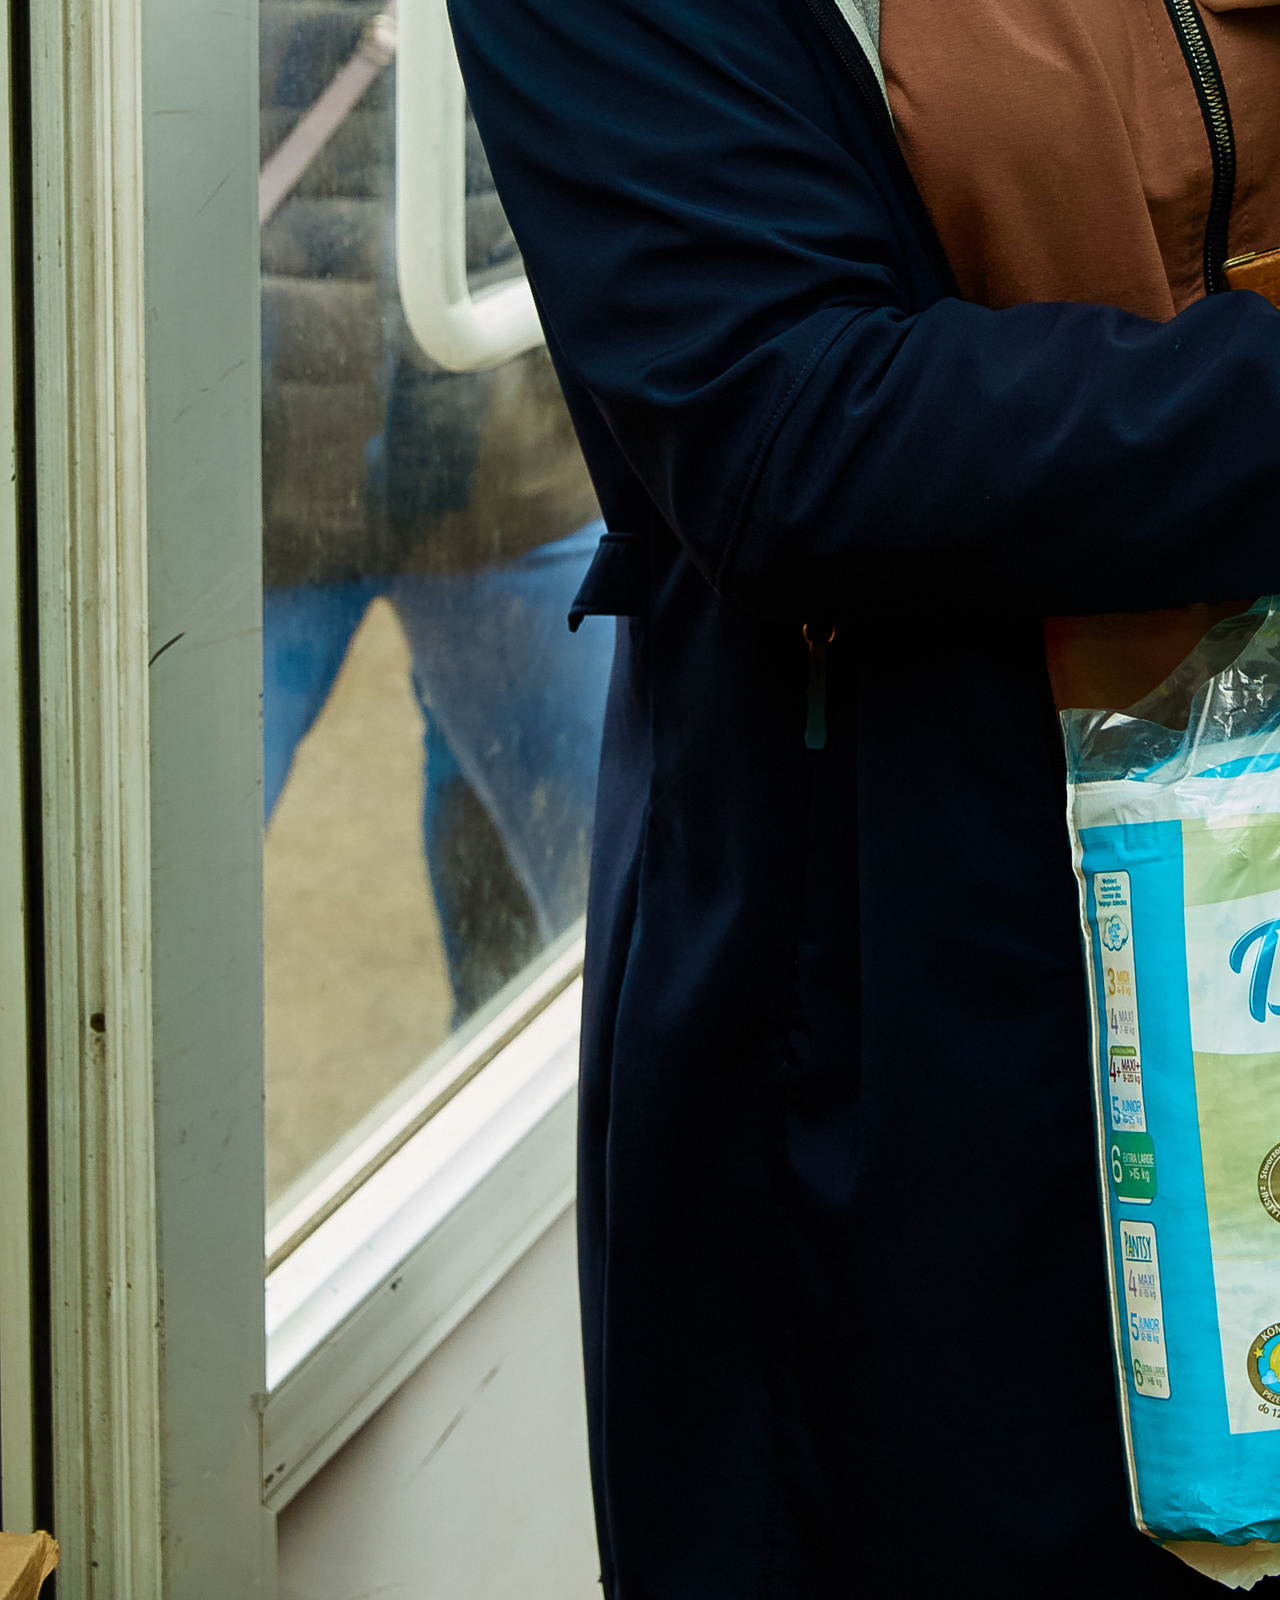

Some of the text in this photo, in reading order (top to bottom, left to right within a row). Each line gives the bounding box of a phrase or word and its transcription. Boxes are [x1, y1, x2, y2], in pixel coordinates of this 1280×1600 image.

[1107, 967, 1116, 995] 3
[1111, 1007, 1134, 1035] 4 MAXI
[1112, 1096, 1142, 1124] 5 JUNIOR
[1111, 1144, 1154, 1183] 6 EXTRA LARGE
[1141, 1168, 1150, 1183] kg
[1129, 1269, 1155, 1297] 4 MAXI
[1130, 1312, 1160, 1341] 5 JUNIOR
[1134, 1359, 1143, 1387] 6
[1258, 1403, 1269, 1414] do
